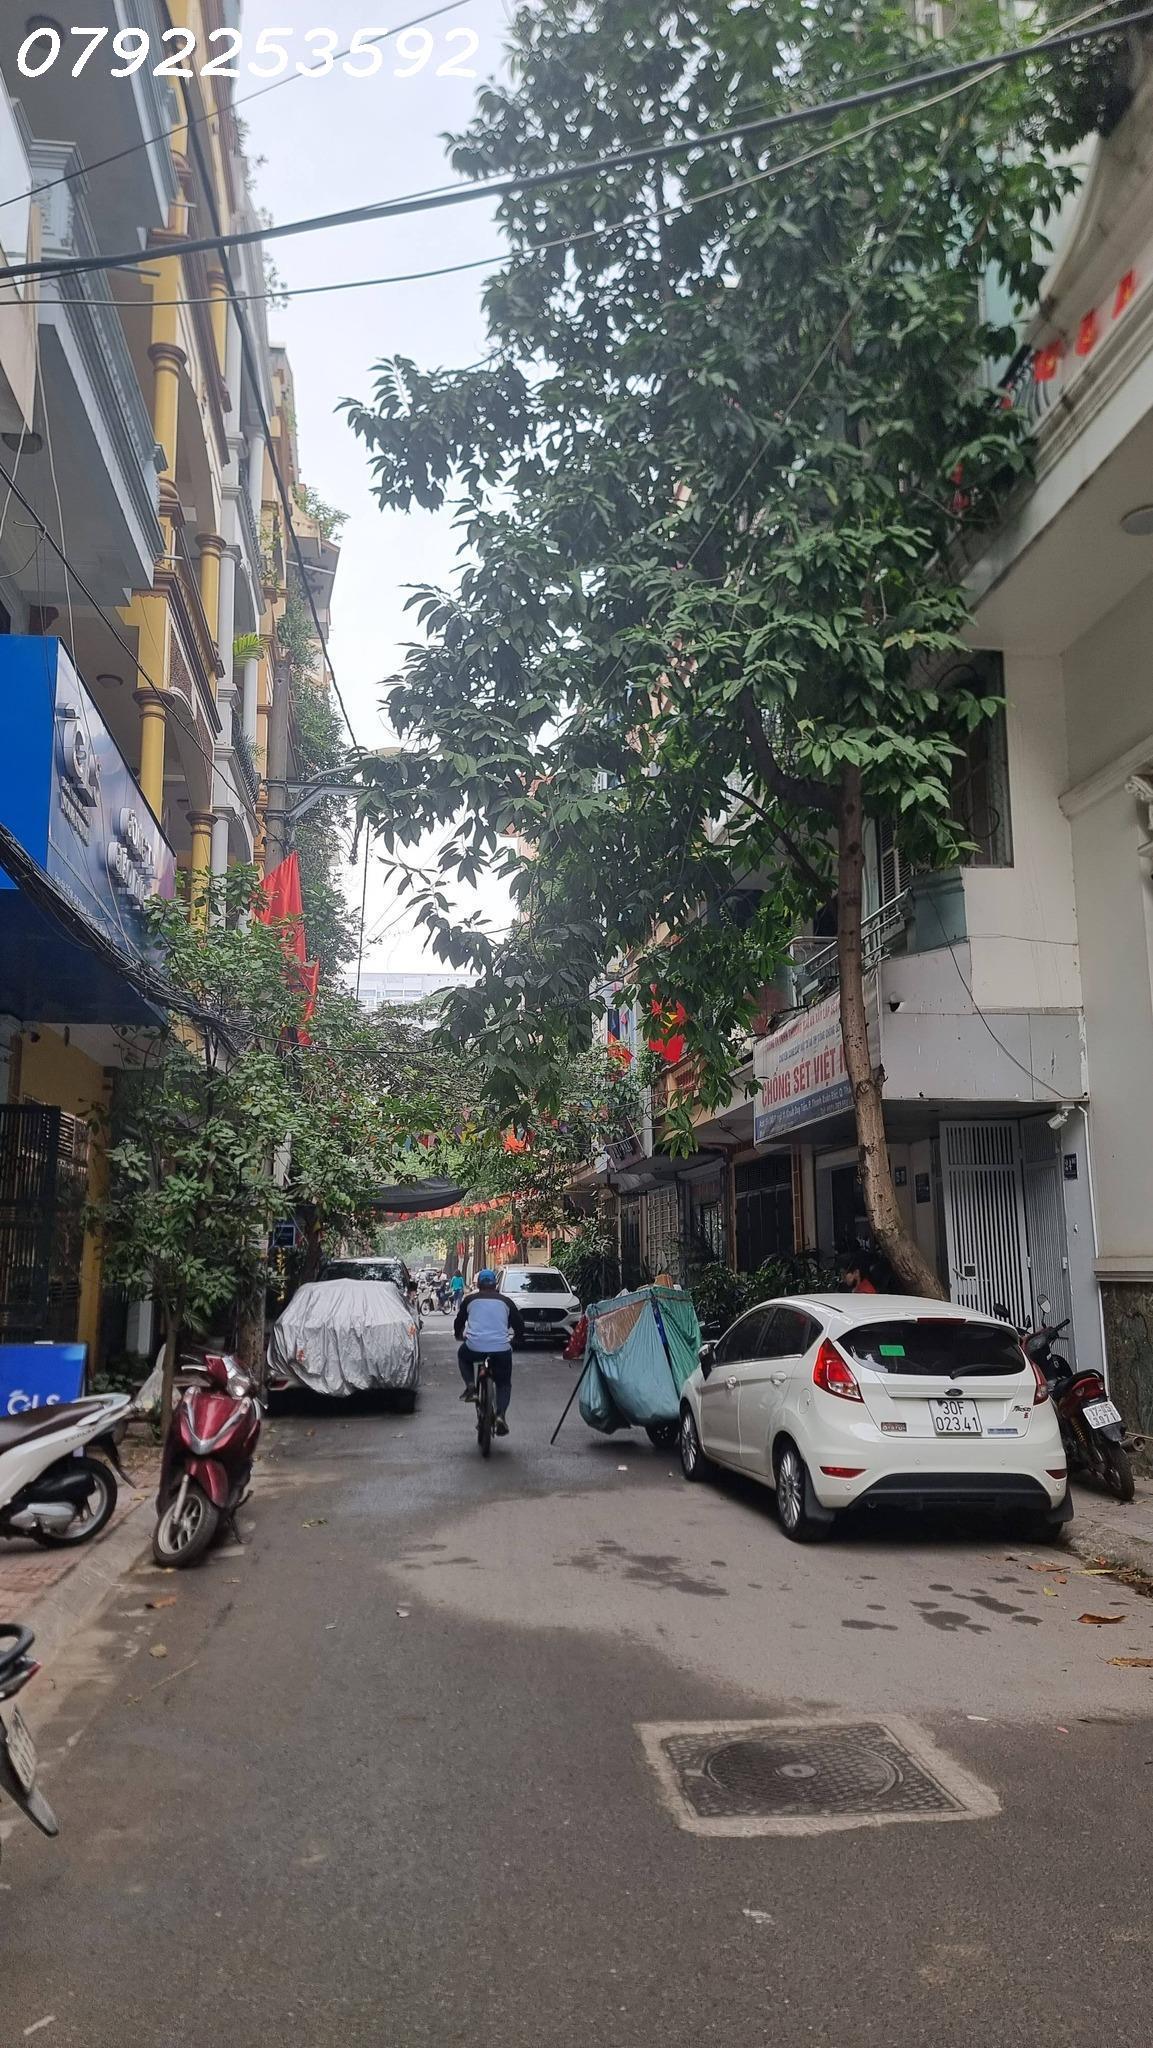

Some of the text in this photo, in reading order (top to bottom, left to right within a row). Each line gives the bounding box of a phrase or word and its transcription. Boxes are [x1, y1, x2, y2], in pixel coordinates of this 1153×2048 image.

[762, 1066, 791, 1109] CHỐNG
[793, 1057, 811, 1094] SÉT
[813, 1045, 836, 1087] VIỆT
[942, 1400, 964, 1415] 30F
[936, 1416, 979, 1431] 023.41
